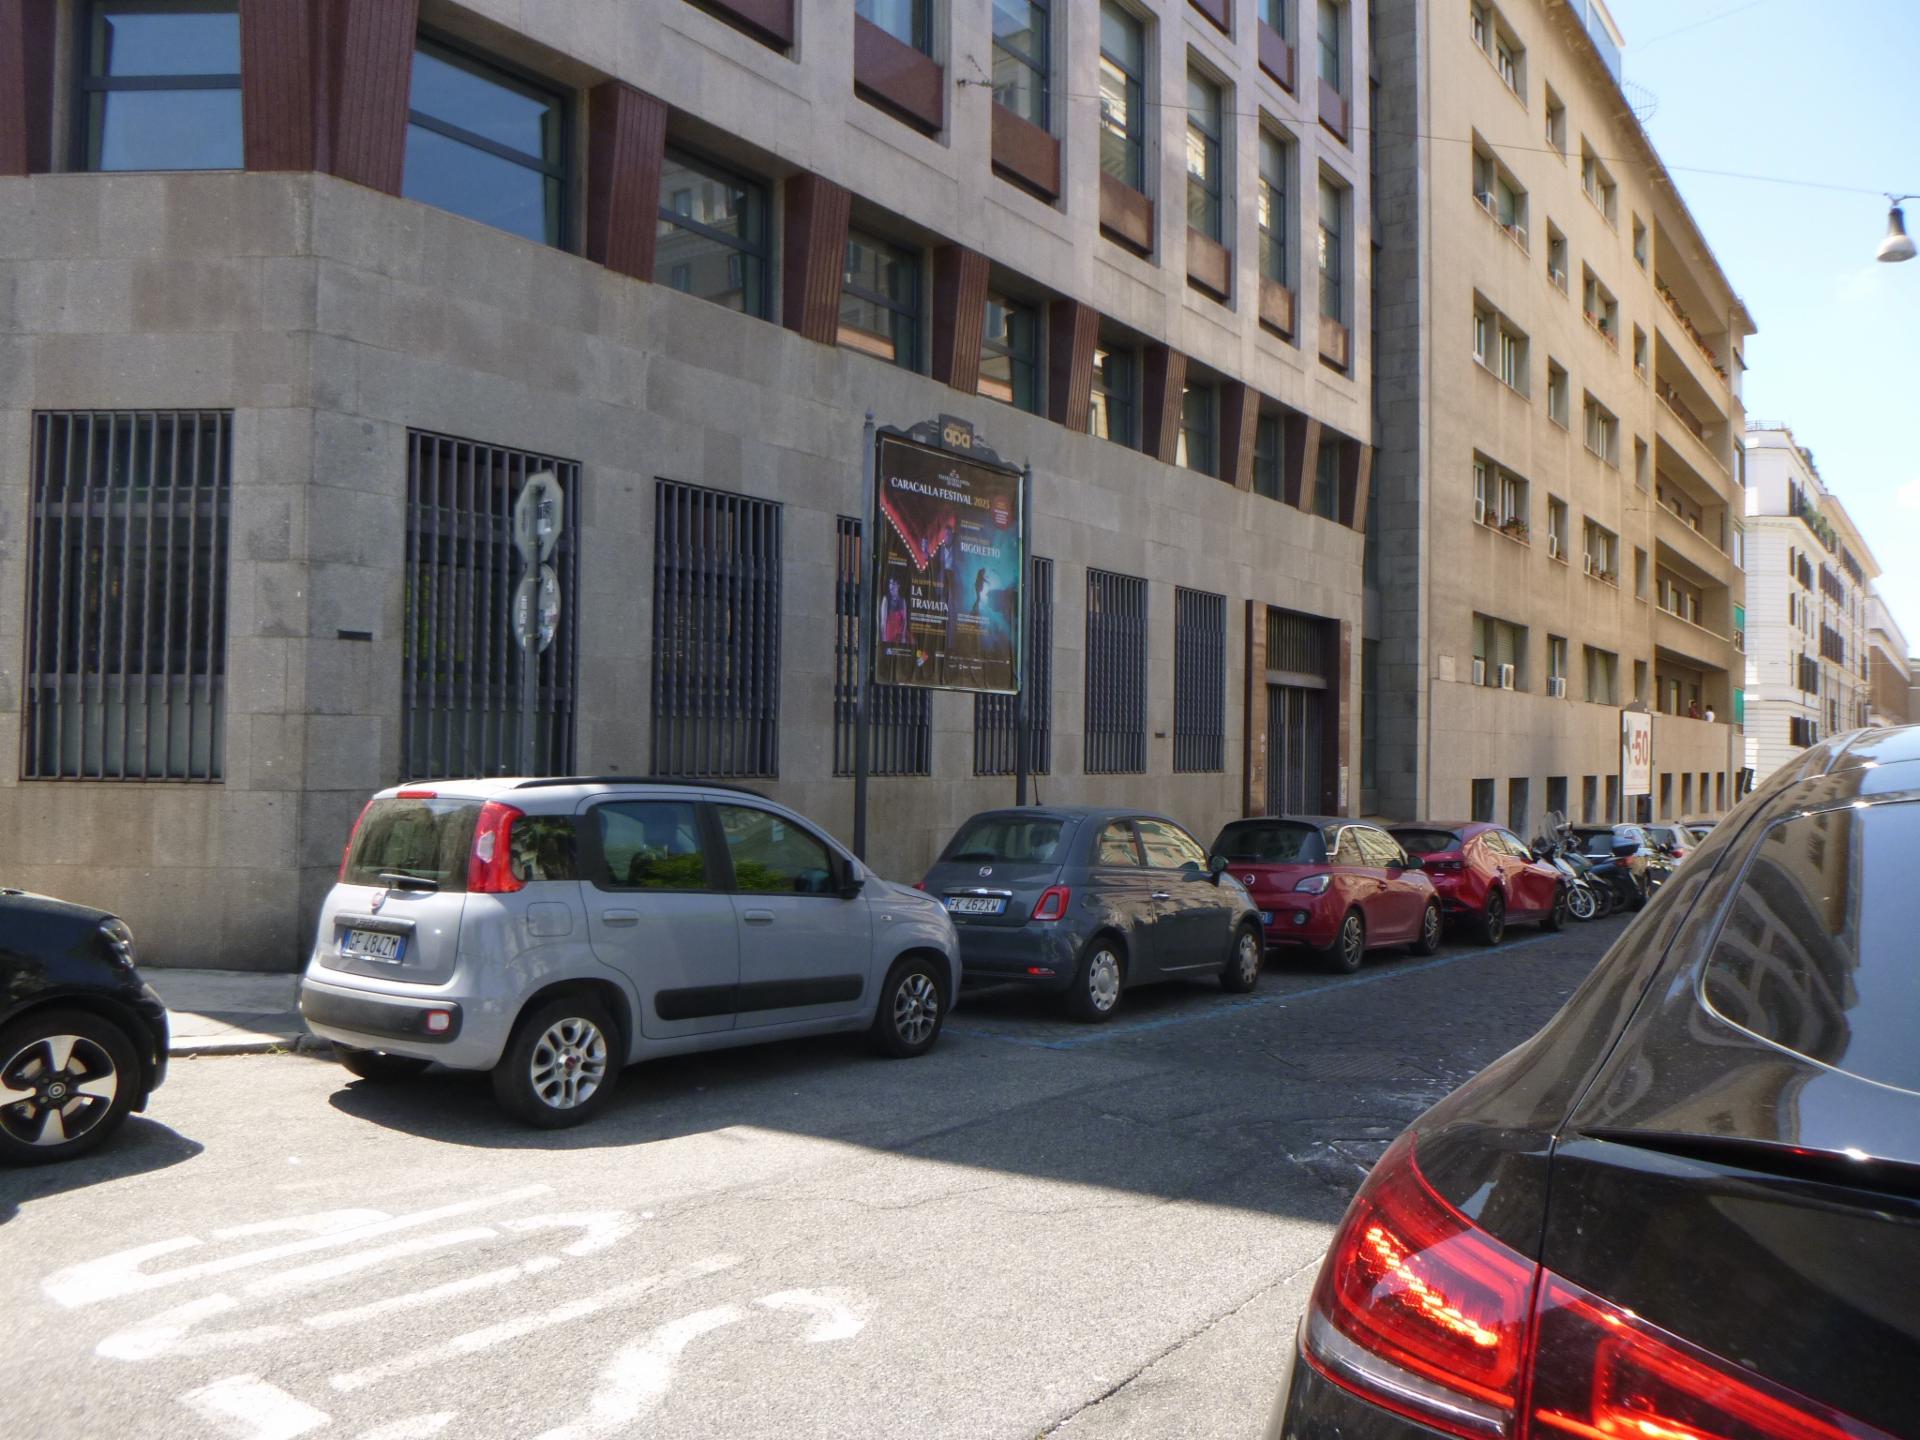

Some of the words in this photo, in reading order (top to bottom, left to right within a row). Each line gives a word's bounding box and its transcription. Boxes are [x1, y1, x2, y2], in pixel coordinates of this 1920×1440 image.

[891, 477, 938, 498] CARACALLA
[939, 488, 972, 505] FESTIVAL
[960, 542, 1001, 559] RIGOLETTO
[911, 585, 923, 597] LA
[911, 598, 949, 612] TRAVIATA
